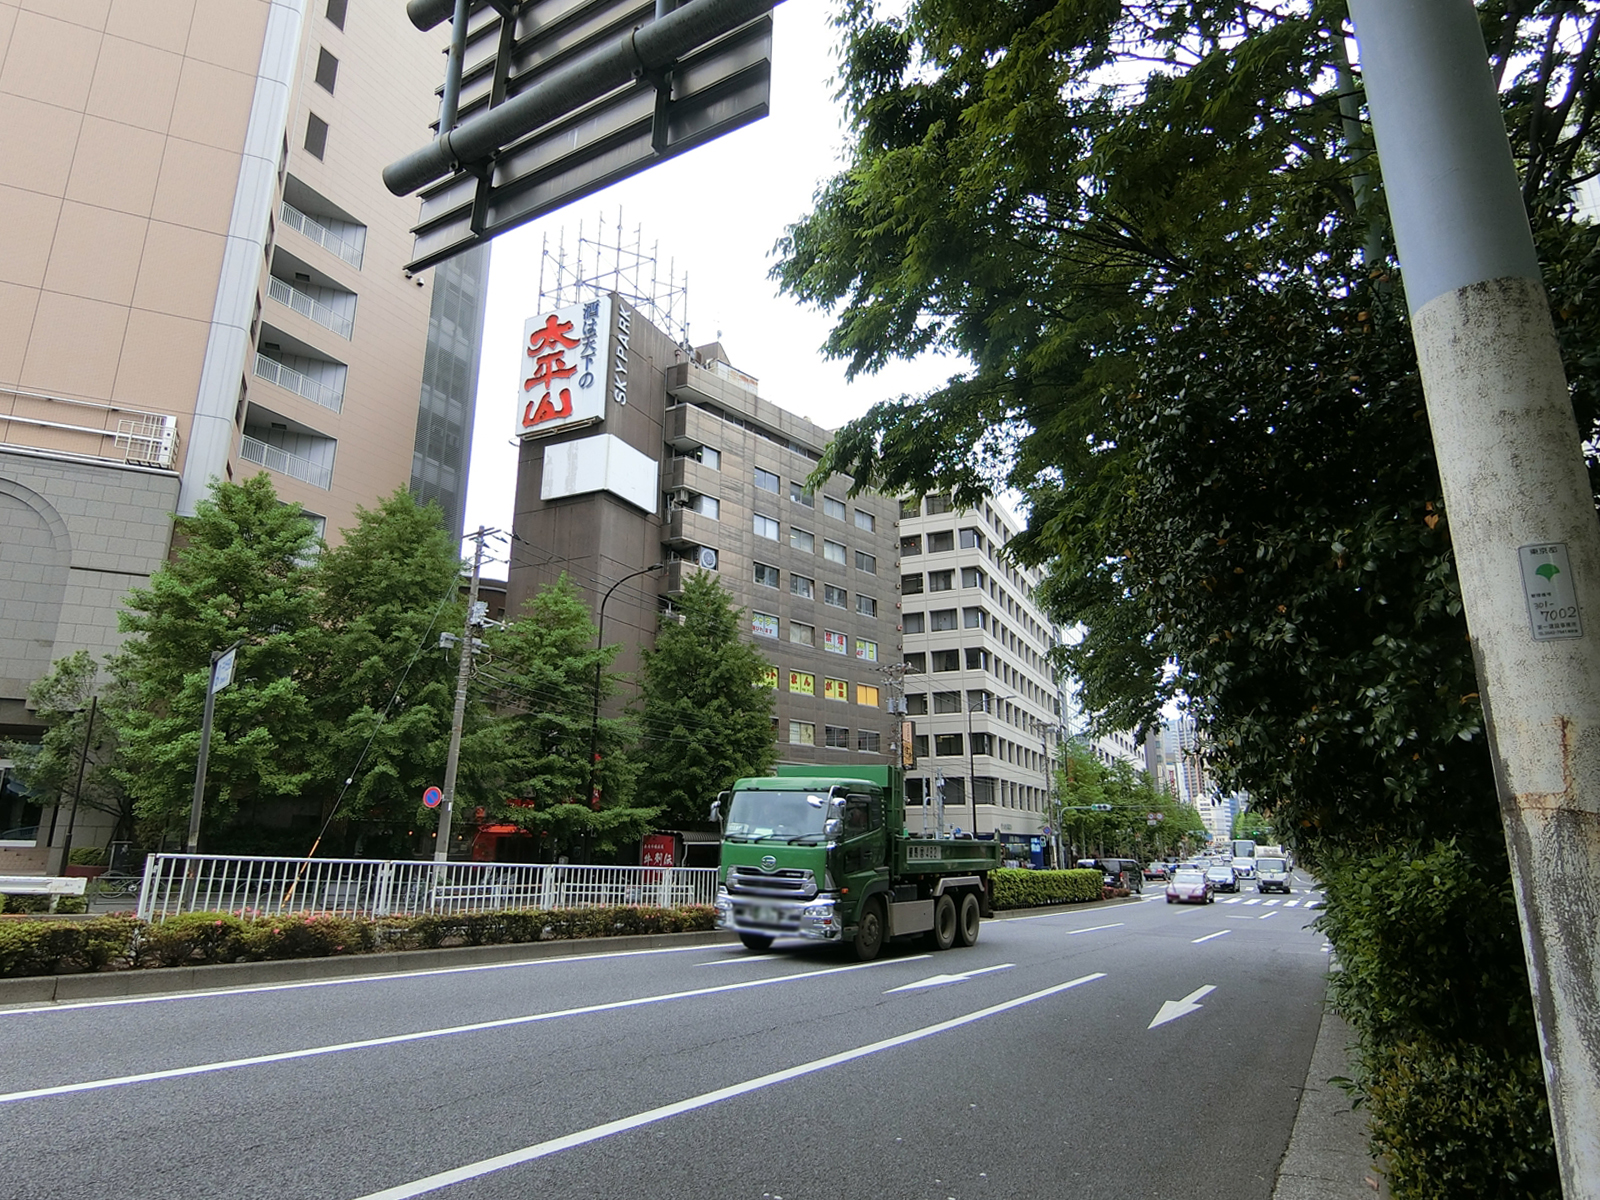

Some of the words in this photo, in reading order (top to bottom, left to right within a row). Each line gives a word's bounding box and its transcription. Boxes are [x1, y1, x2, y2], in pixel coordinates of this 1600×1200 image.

[522, 313, 581, 429] 太平山
[578, 299, 602, 390] 酒は天下の
[613, 303, 632, 406] SKYPARK
[1529, 546, 1558, 555] 東京都
[1540, 606, 1577, 622] 7002
